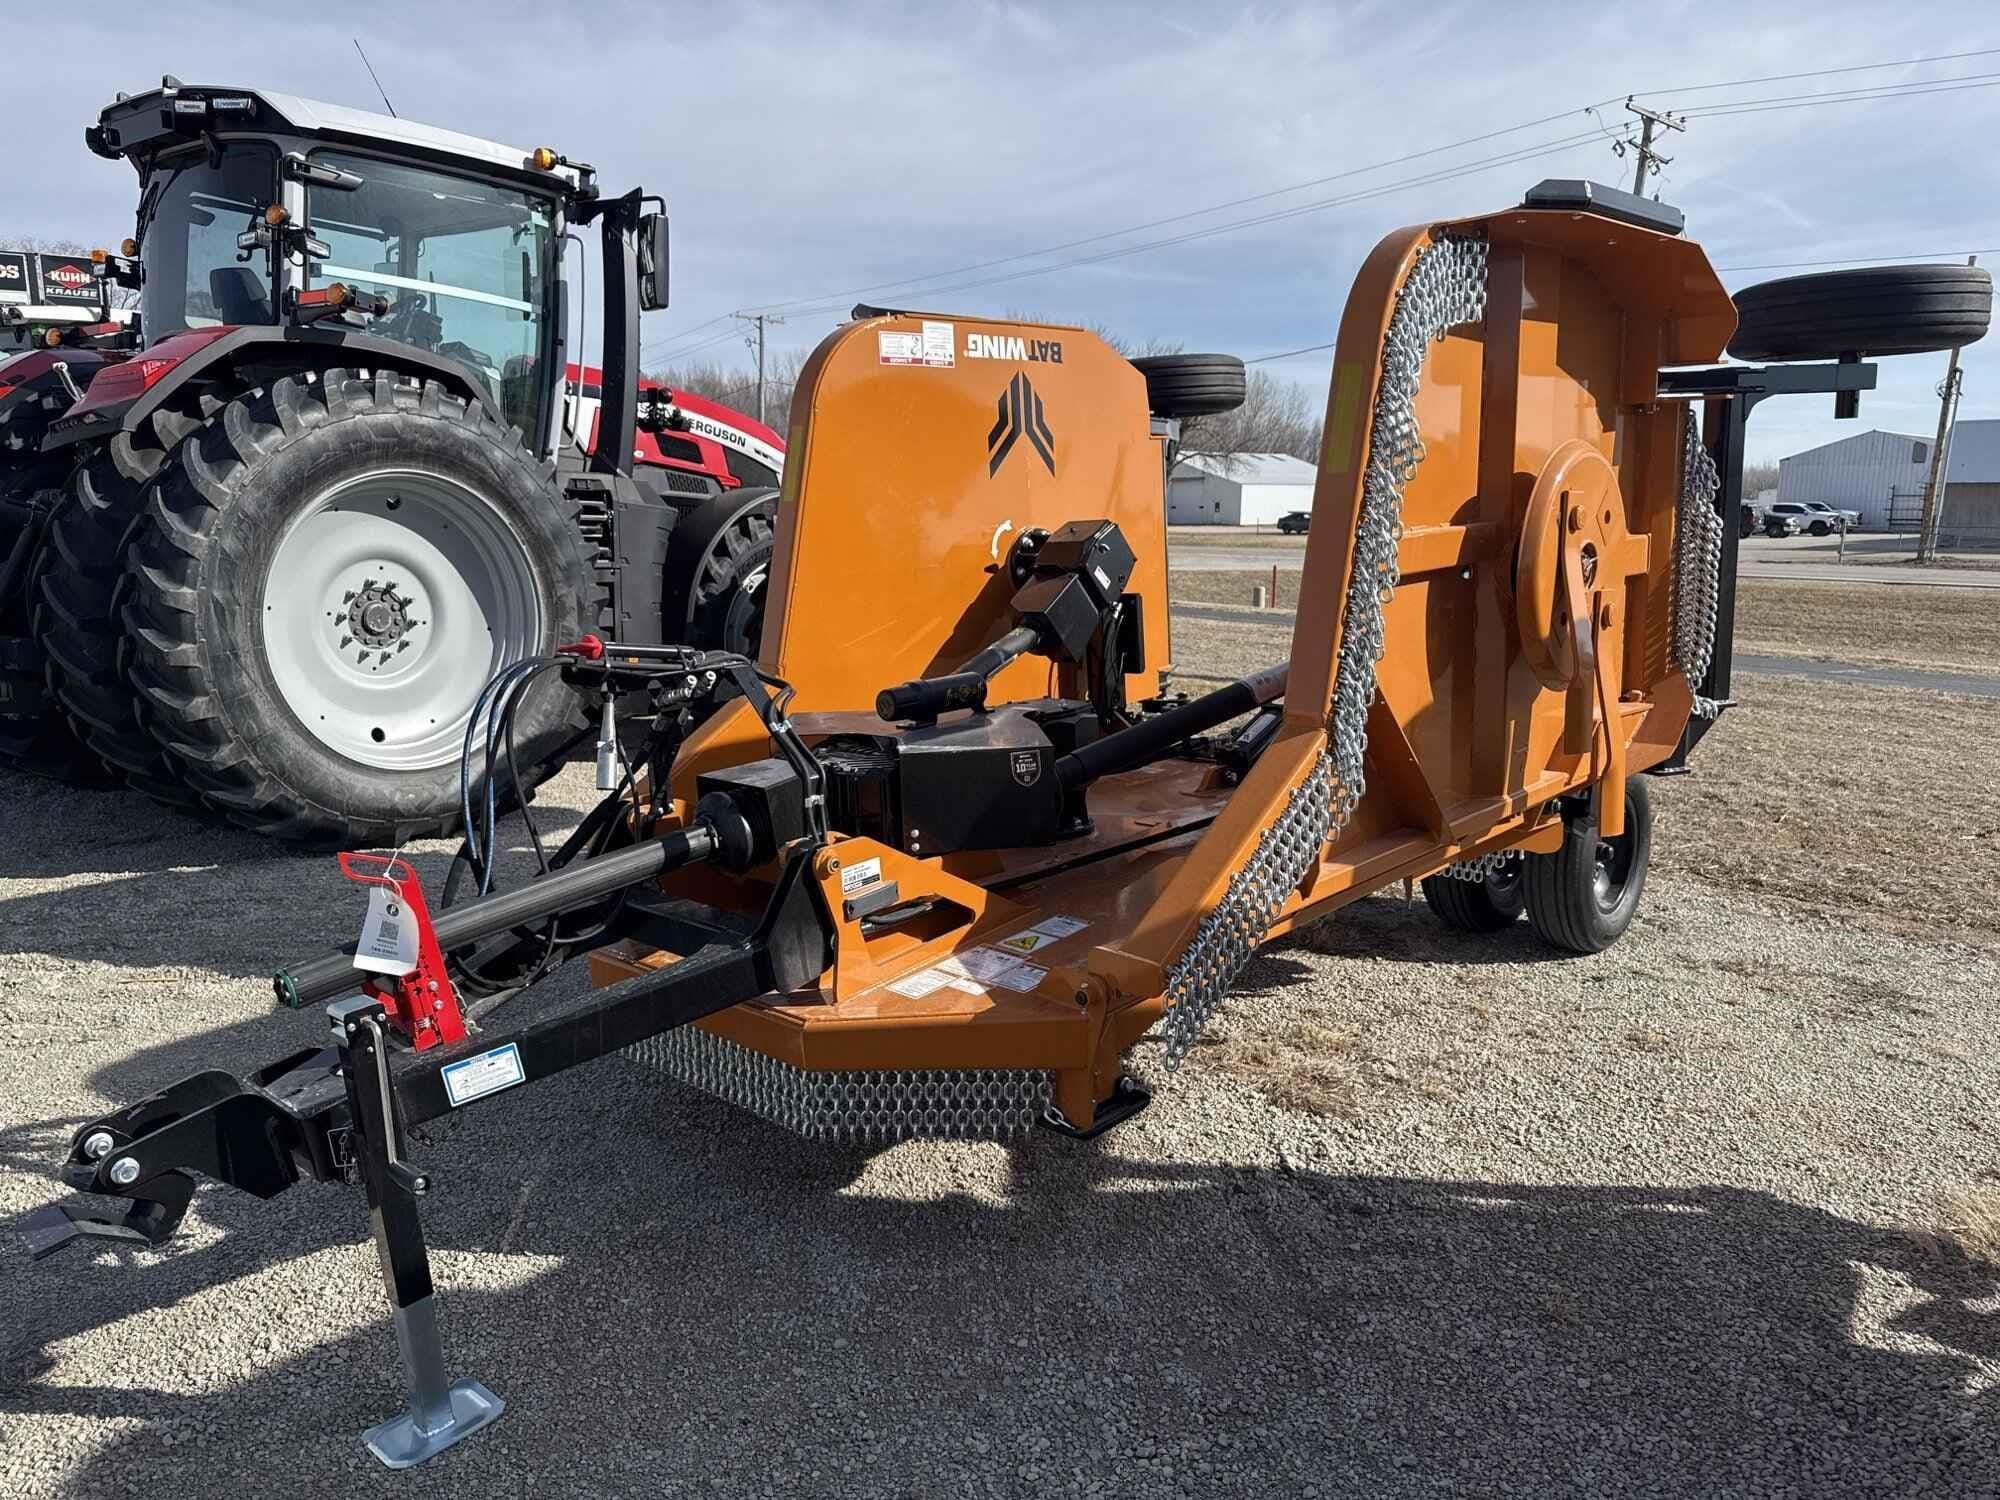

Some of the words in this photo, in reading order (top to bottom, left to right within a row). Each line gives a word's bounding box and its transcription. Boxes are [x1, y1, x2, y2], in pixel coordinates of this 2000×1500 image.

[50, 270, 90, 284] KUHN
[46, 287, 97, 298] KRAUSE
[966, 333, 1063, 364] BATWING
[687, 417, 747, 448] ERGUSON
